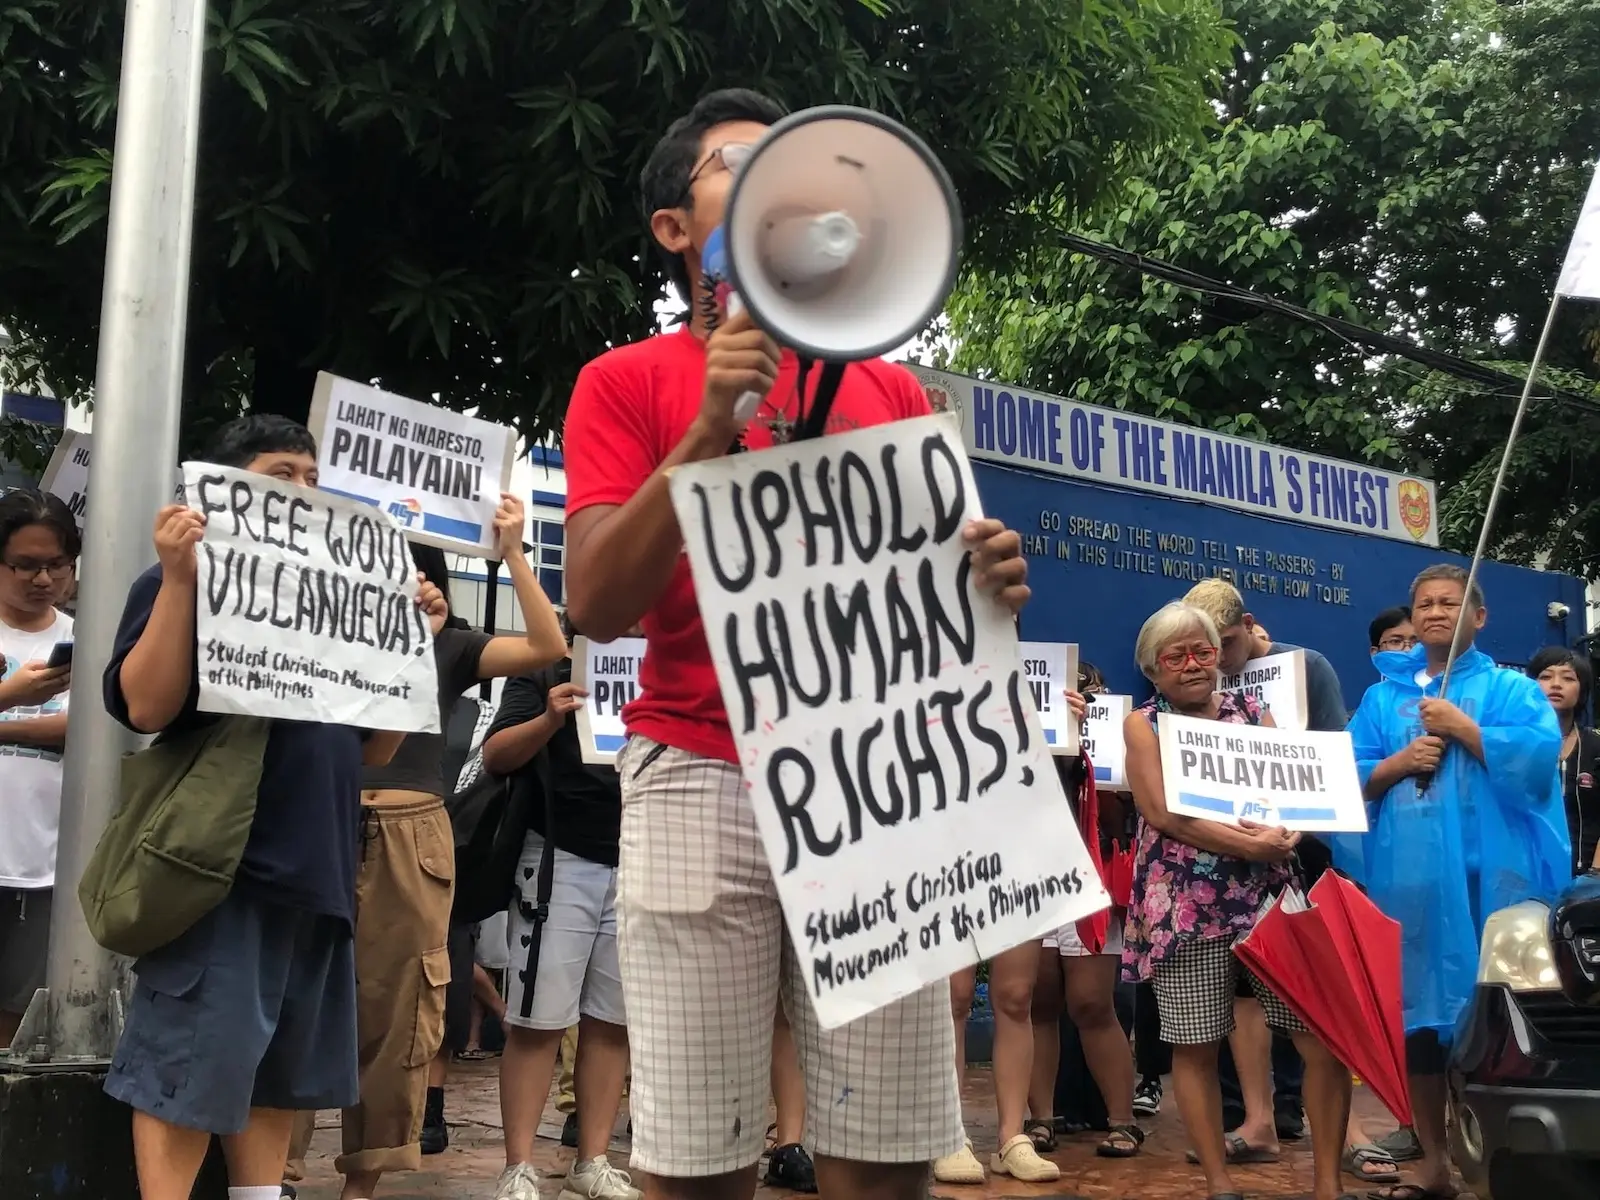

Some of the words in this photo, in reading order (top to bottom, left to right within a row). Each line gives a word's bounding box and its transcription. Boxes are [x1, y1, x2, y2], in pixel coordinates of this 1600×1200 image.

[329, 427, 483, 502] PALAYAIN!
[336, 400, 386, 432] LAHAT
[388, 415, 409, 440] NG
[411, 422, 485, 462] INARESTO,
[973, 386, 1063, 465] HOME
[1070, 408, 1105, 473] OF
[1113, 417, 1167, 486] THE
[1172, 430, 1304, 514] MANILA'S
[1308, 461, 1390, 530] FINEST
[198, 474, 312, 556] FREE
[693, 433, 965, 593] UPHOLD
[1040, 510, 1061, 531] GO
[1069, 515, 1121, 542] SPREAD
[1127, 526, 1152, 548] THE
[1158, 532, 1195, 556] WORD
[1202, 539, 1230, 562] TELL
[1236, 545, 1260, 567] THE
[1265, 551, 1316, 576] PASSERS
[1331, 563, 1344, 581] BY
[203, 543, 426, 657] VILLANUEVA!
[1021, 533, 1050, 555] HAT
[1058, 540, 1070, 560] IN
[1078, 543, 1107, 566] THIS
[1114, 550, 1155, 573] LITTLE
[1162, 557, 1206, 582] WORLD
[1244, 571, 1278, 594] KNEW
[1284, 577, 1310, 598] HOW
[207, 638, 268, 668] Student
[272, 651, 339, 683] Christian
[342, 669, 412, 700] Movement
[594, 655, 634, 675] LAHAT
[725, 550, 976, 734] HUMAN
[1221, 674, 1241, 690] ANG
[1244, 665, 1281, 686] KORAP!
[208, 667, 223, 684] of
[224, 668, 243, 688] the
[247, 669, 314, 700] Philippines
[767, 671, 1035, 877] RIGHTS!
[1178, 729, 1220, 750] LAHAT
[1226, 737, 1245, 753] NG
[1249, 740, 1322, 762] INARESTO,
[1180, 749, 1326, 792] PALAYAIN!
[1240, 801, 1273, 820] ACT
[804, 880, 897, 948] Student
[906, 850, 1002, 913] Christian
[812, 928, 909, 998] Movement
[919, 912, 941, 950] of
[950, 902, 985, 942] the
[988, 867, 1082, 924] Philippines
